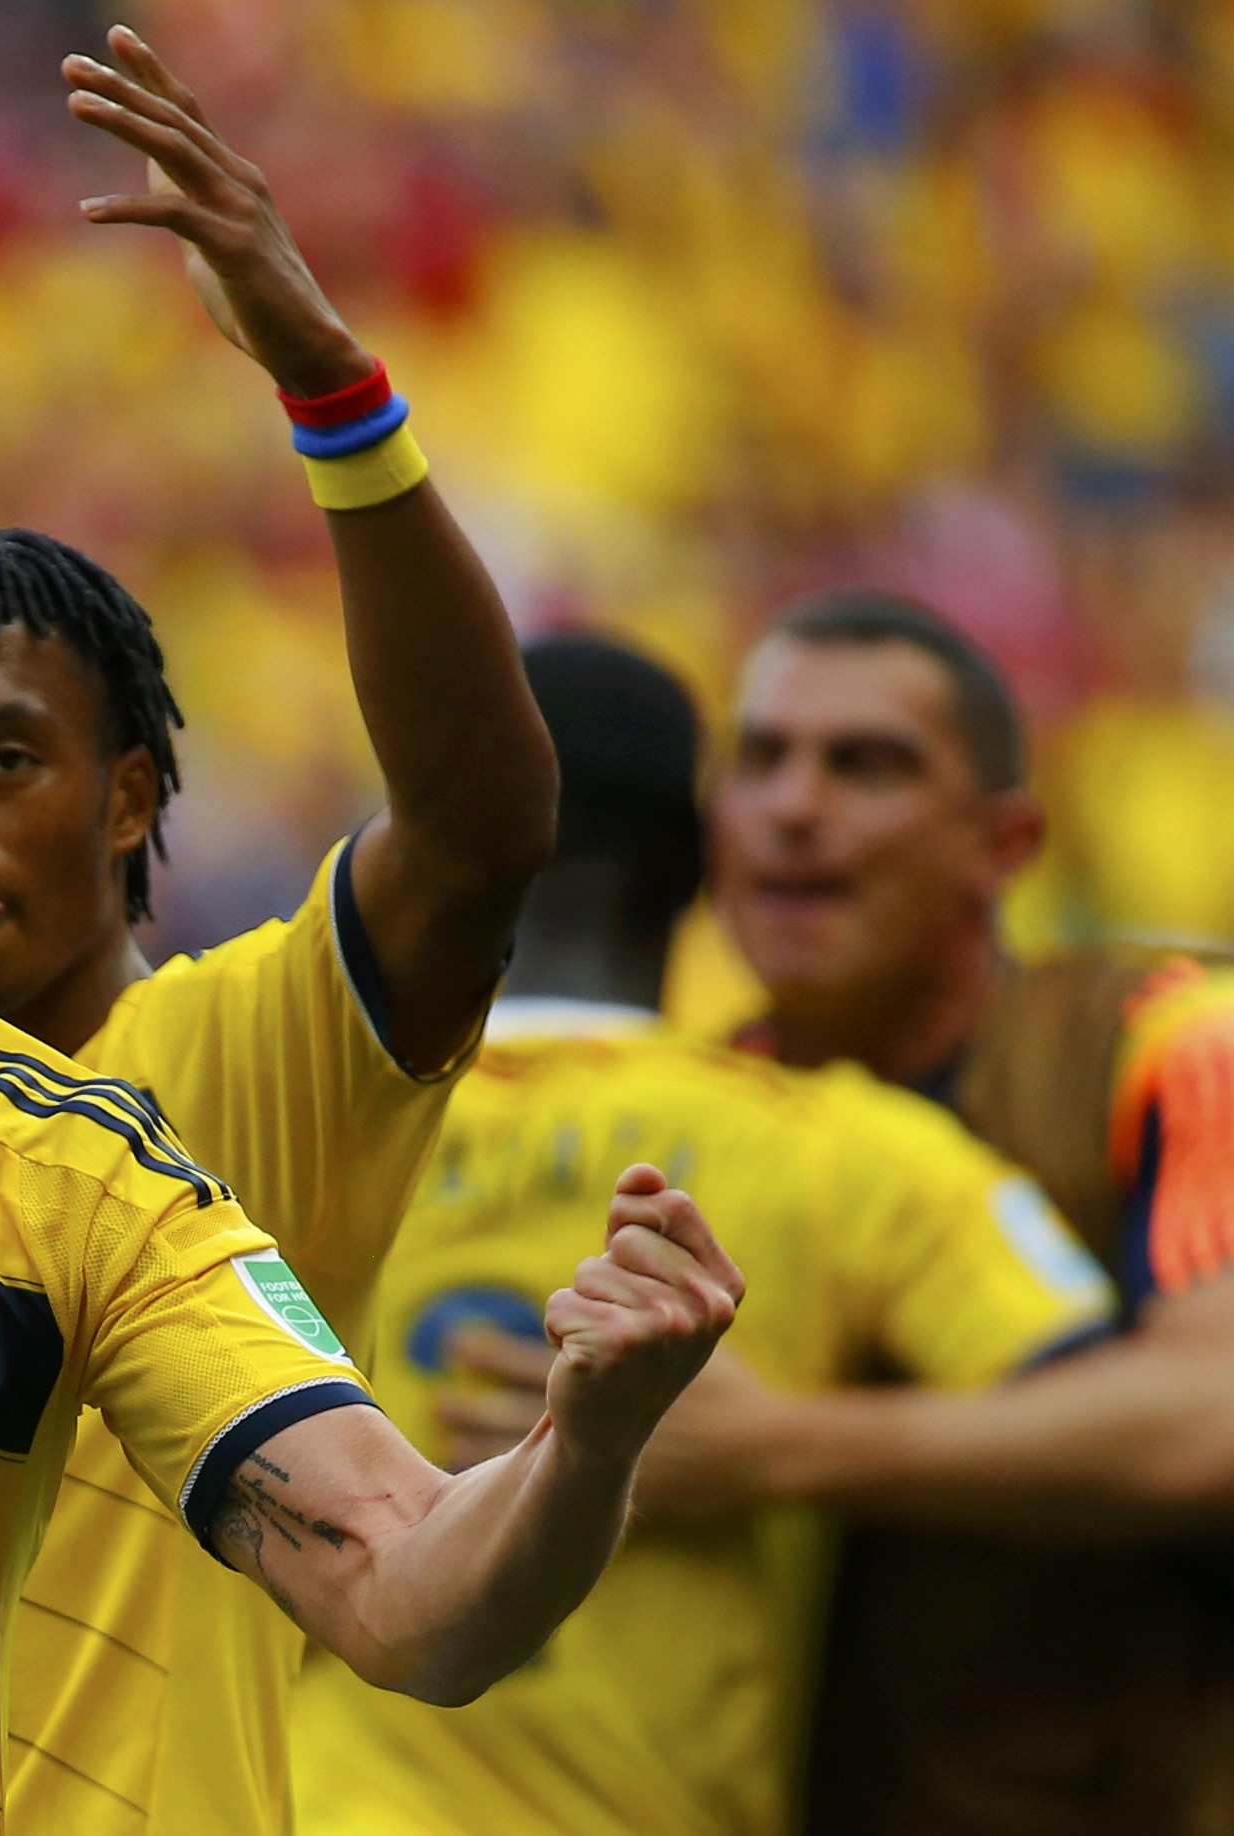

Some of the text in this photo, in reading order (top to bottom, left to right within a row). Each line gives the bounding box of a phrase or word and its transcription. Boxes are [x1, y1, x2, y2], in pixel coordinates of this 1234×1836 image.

[260, 1281, 304, 1292] FOOTBA
[267, 1291, 310, 1302] FOR HO
